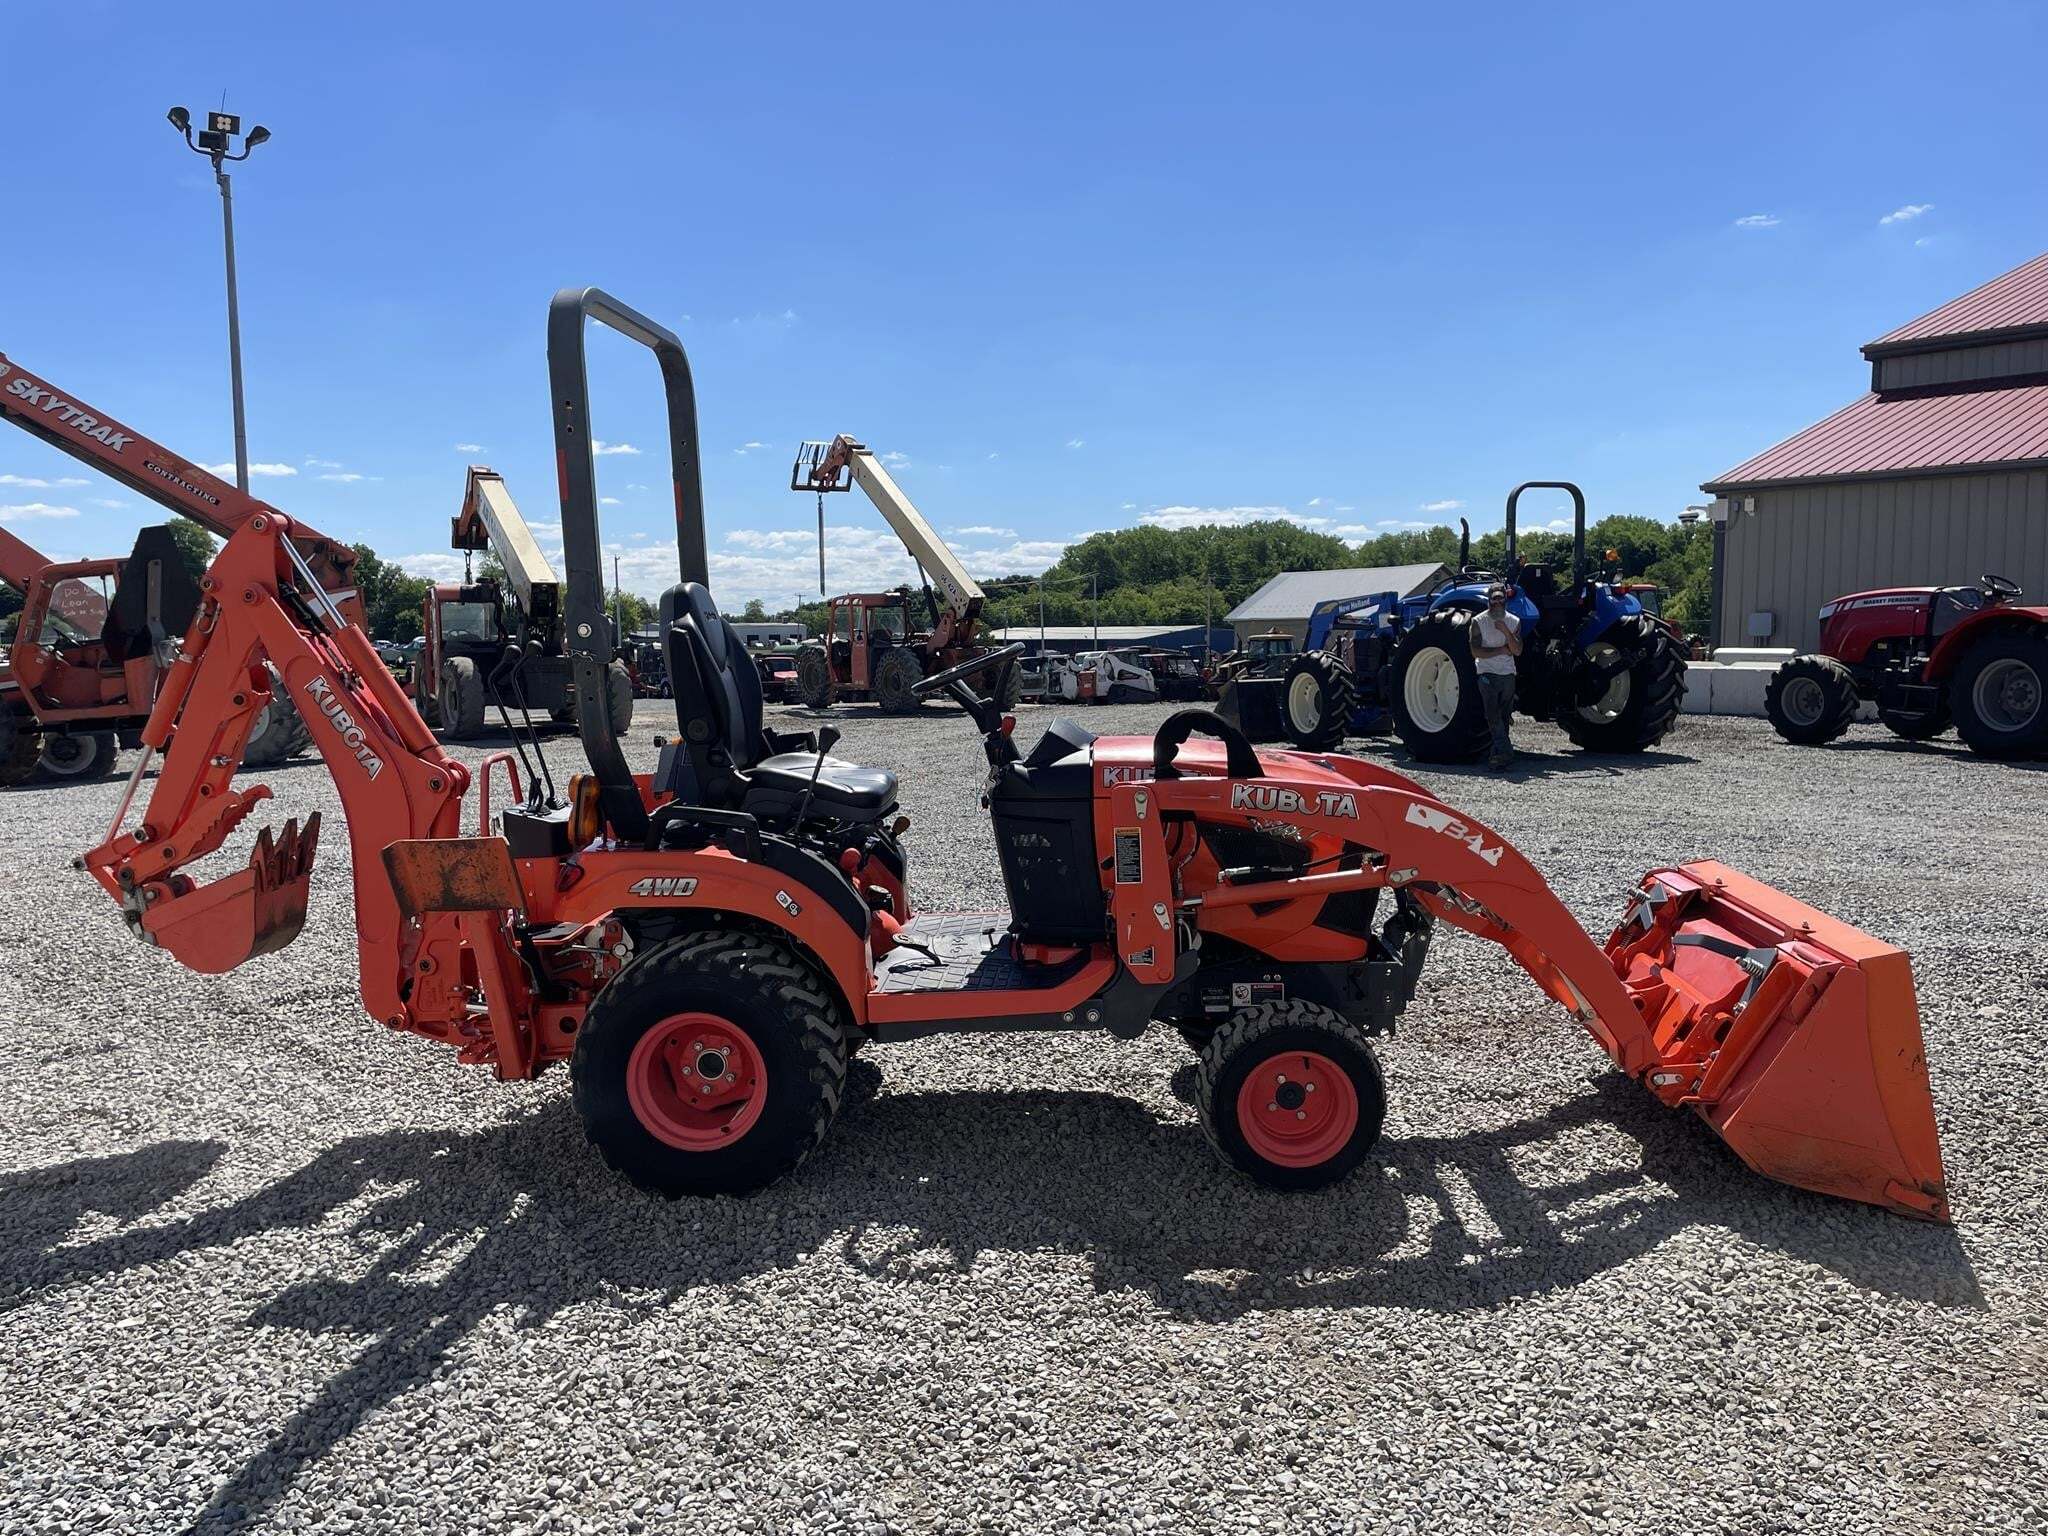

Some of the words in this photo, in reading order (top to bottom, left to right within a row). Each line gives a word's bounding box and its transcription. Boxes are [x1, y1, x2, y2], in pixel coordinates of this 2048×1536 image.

[6, 378, 136, 454] SKYTRAK
[147, 463, 217, 504] CONTRACTING
[304, 675, 384, 781] KUBOTA
[1231, 783, 1360, 820] KUBOTA
[629, 877, 698, 897] 4WD
